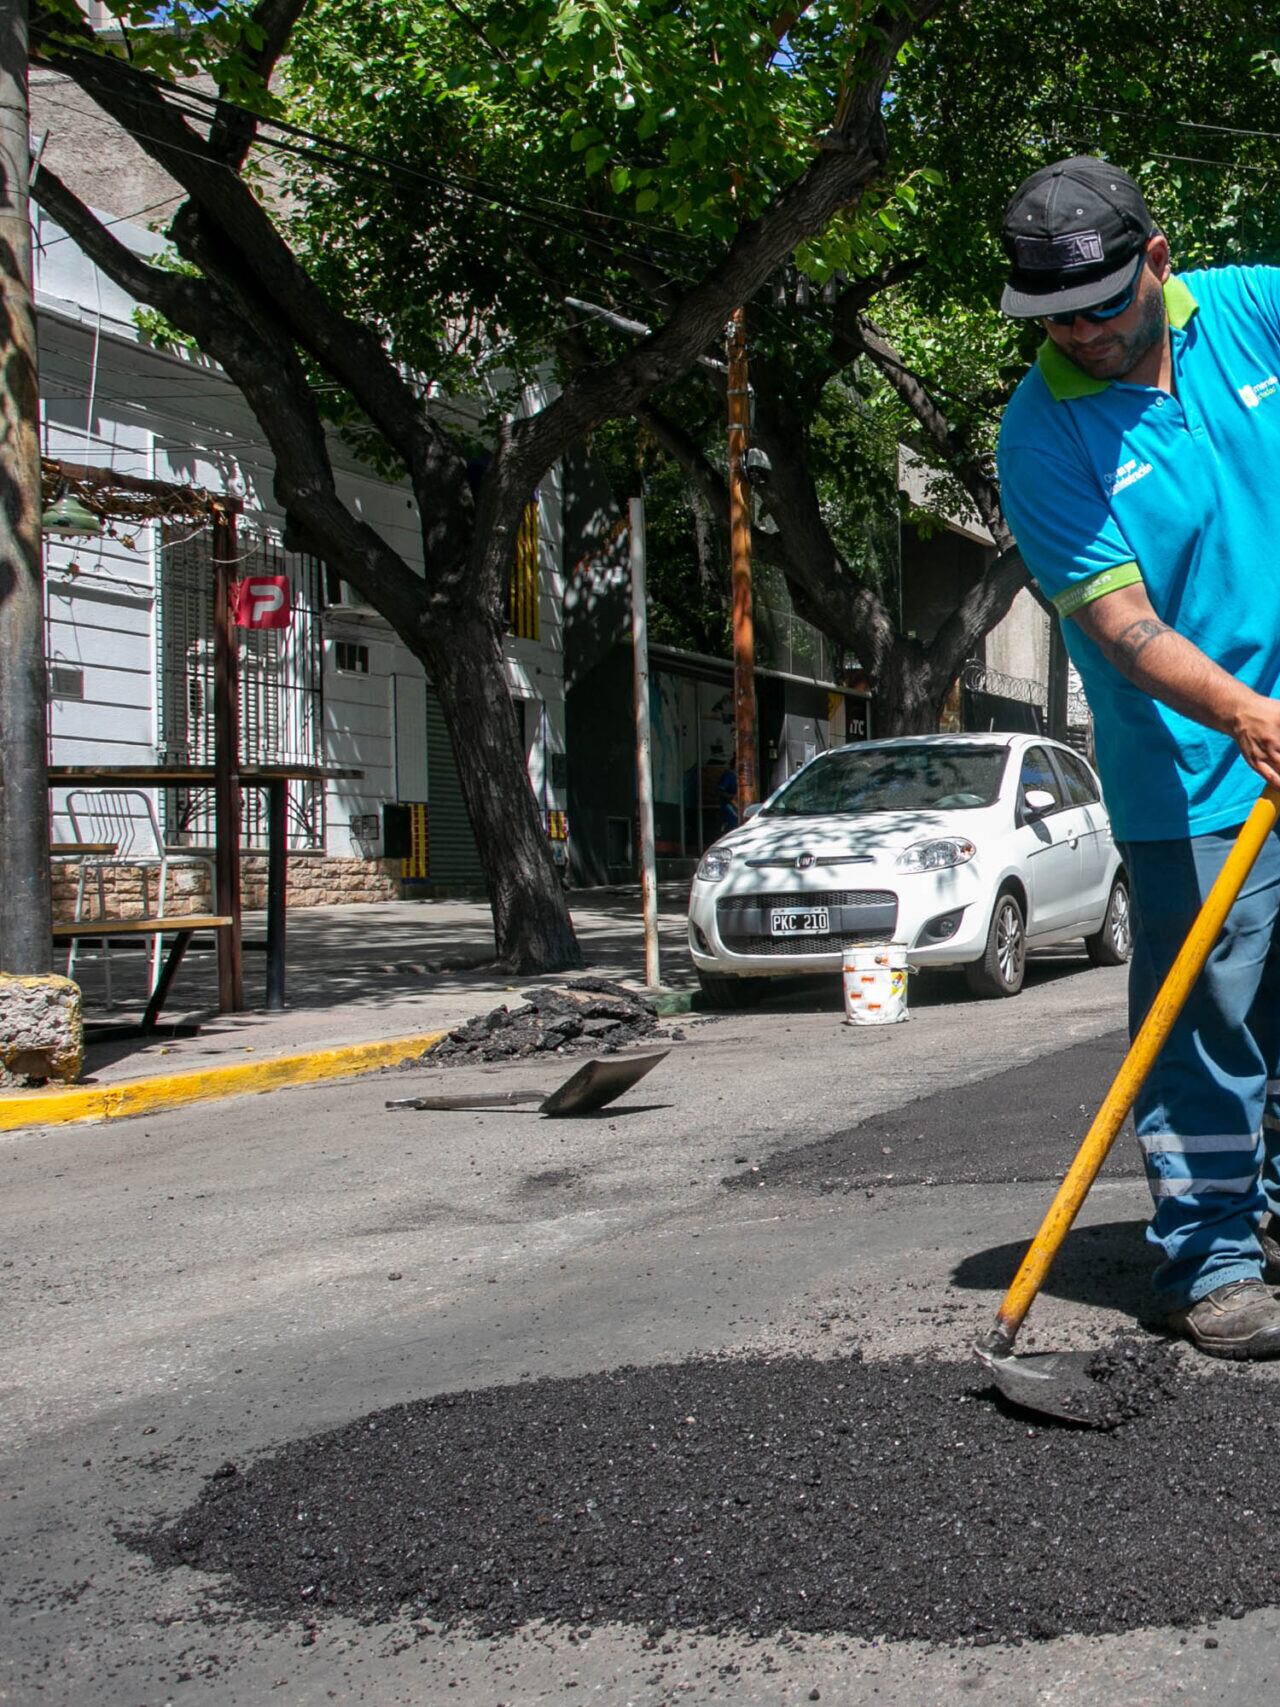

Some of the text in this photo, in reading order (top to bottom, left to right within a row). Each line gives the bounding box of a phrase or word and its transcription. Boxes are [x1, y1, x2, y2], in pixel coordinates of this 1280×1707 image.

[250, 585, 284, 621] P
[773, 914, 827, 930] PKC 210
